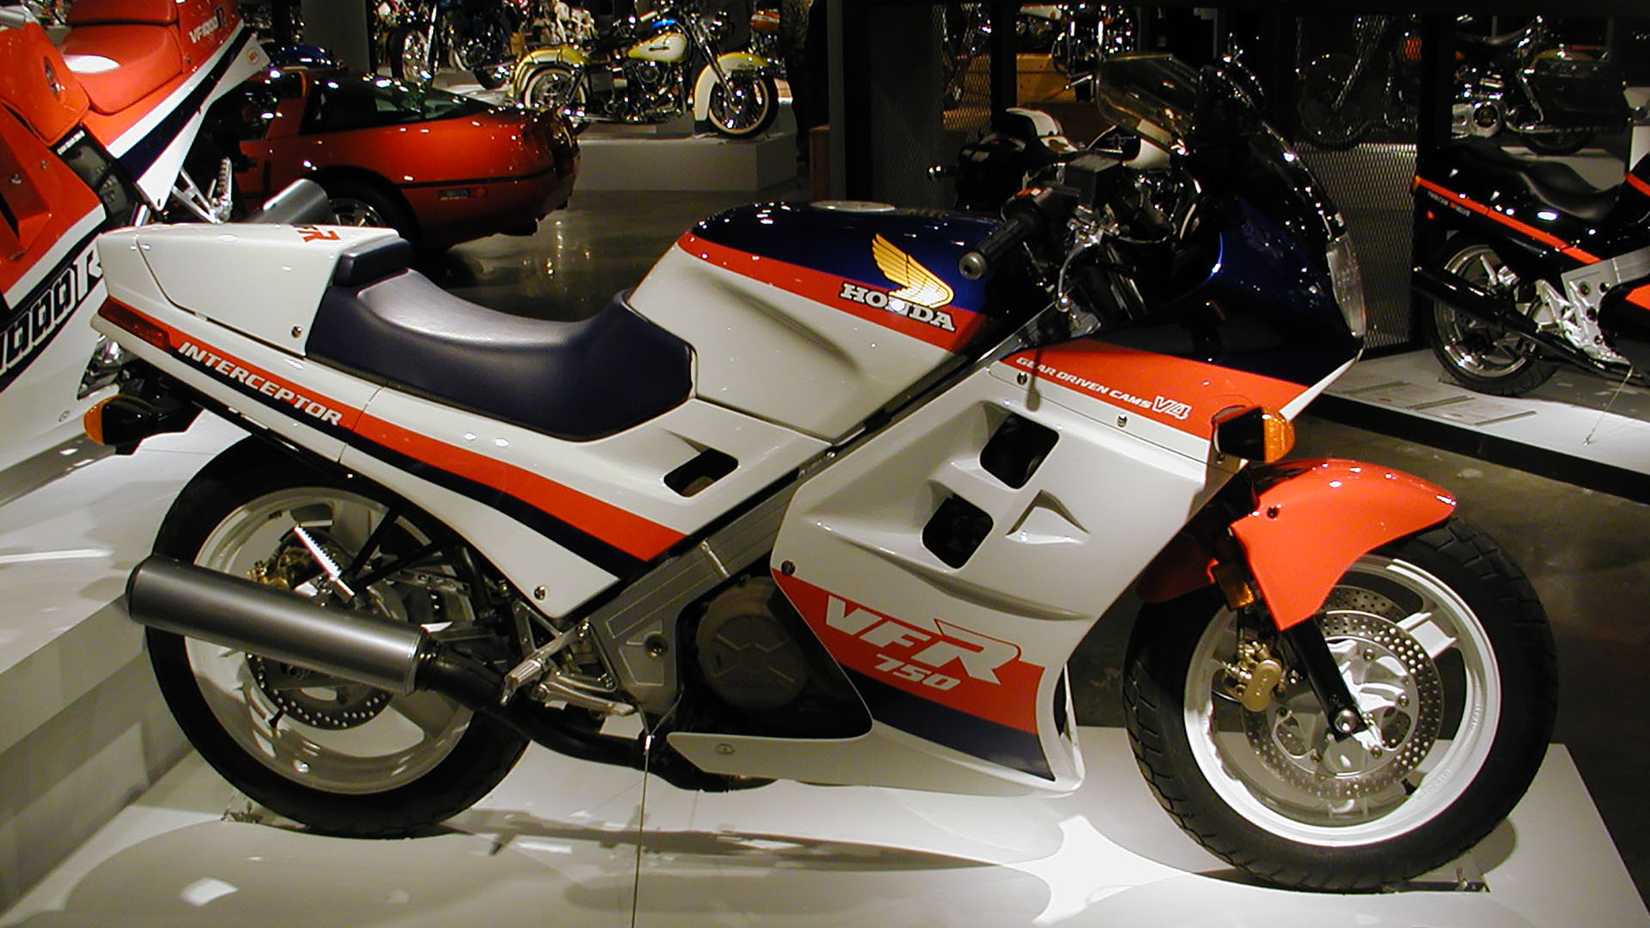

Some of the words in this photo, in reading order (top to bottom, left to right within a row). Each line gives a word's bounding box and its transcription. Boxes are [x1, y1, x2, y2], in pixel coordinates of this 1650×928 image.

[839, 282, 956, 332] HONDA
[177, 341, 344, 427] INTERCEPTOR
[1015, 356, 1057, 377] GEAR
[1055, 371, 1111, 395] DRIVEN
[1108, 388, 1152, 410] CAMS
[1152, 395, 1193, 420] V4
[825, 594, 1022, 686] VFR
[873, 652, 961, 691] 750
